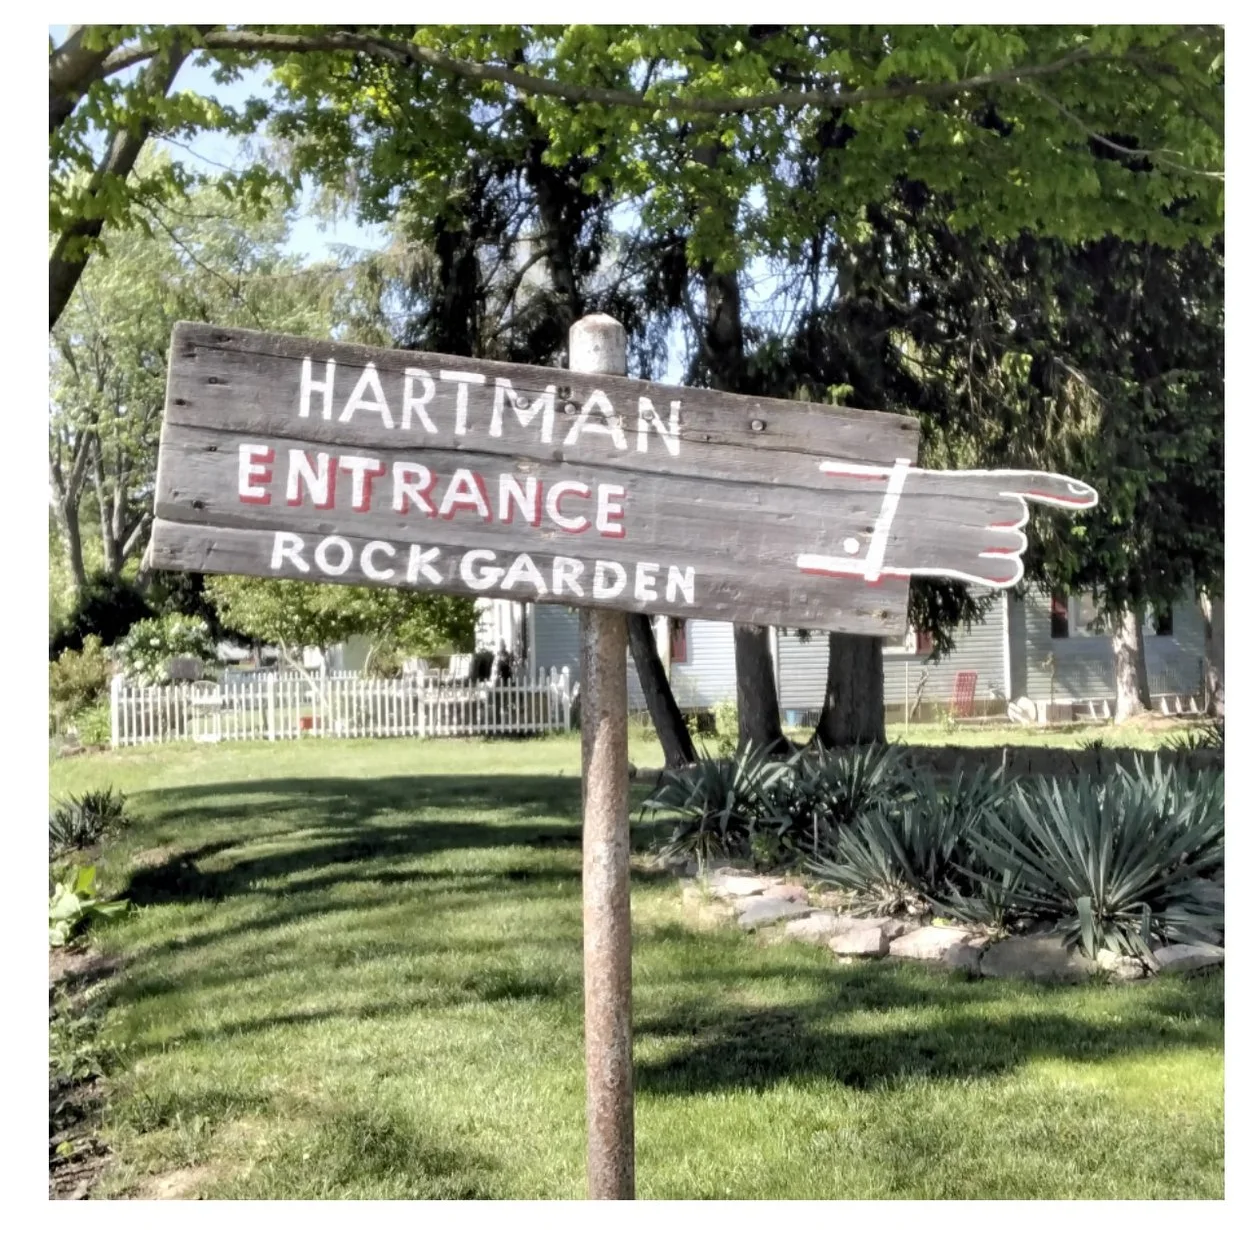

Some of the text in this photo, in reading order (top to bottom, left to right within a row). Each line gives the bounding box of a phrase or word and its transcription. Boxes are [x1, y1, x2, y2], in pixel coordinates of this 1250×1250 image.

[299, 356, 682, 457] HARTMAN
[237, 443, 627, 538] ENTRANCE
[271, 533, 695, 605] ROCK GARDEN
